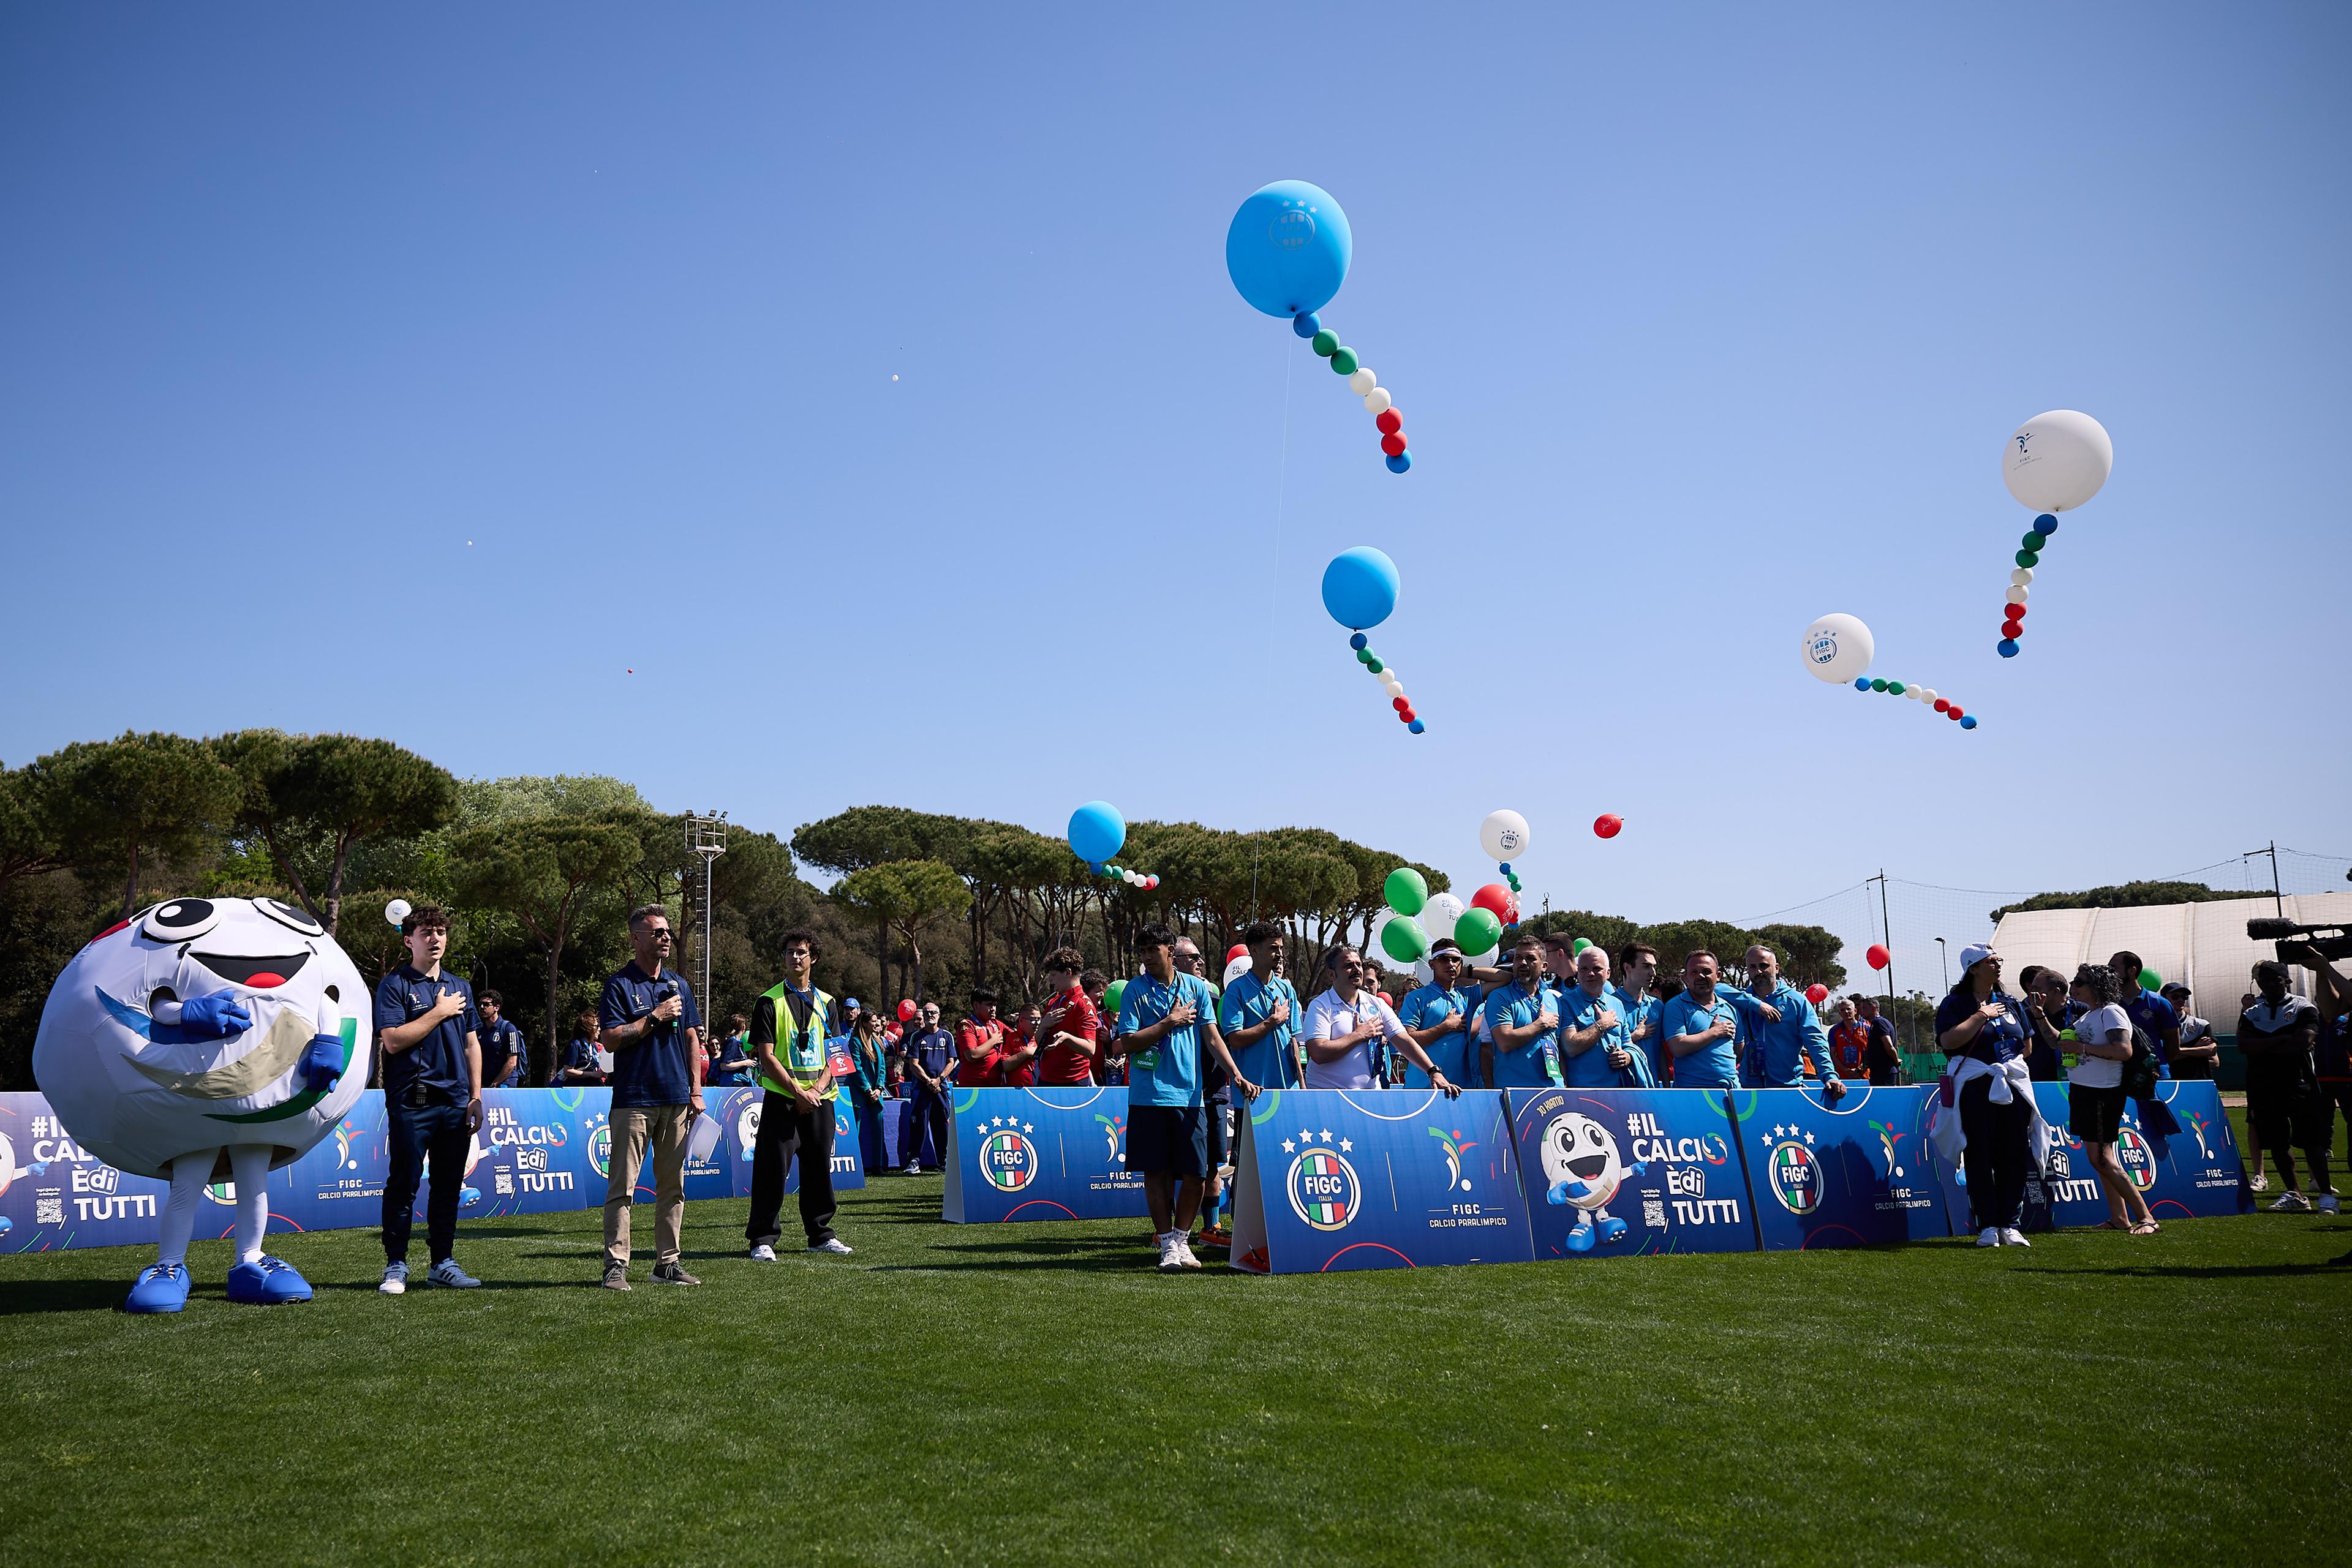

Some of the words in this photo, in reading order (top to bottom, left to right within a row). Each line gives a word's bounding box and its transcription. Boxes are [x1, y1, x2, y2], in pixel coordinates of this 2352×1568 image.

[1815, 646, 1830, 655] FIGC
[488, 1107, 518, 1126] #IL
[1627, 1113, 1665, 1137] #IL
[516, 1147, 531, 1170] È
[527, 1150, 547, 1170] di
[993, 1151, 1023, 1165] FIGC
[2051, 1152, 2069, 1177] di
[2121, 1148, 2144, 1164] FIGC
[71, 1164, 89, 1193] È
[89, 1167, 118, 1193] di
[519, 1172, 574, 1192] TUTTI
[1109, 1172, 1132, 1180] FIGC
[1665, 1164, 1683, 1195] È
[1680, 1167, 1704, 1197] di
[1781, 1166, 1810, 1183] FIGC
[2206, 1169, 2223, 1178] FIGC
[339, 1179, 363, 1189] FIGC
[1304, 1176, 1342, 1195] FIGC
[2047, 1179, 2099, 1202] TUTTI
[318, 1191, 341, 1200] CALCIO
[342, 1189, 383, 1198] PARALIMPICO
[1891, 1188, 1911, 1199] FIGC
[73, 1194, 156, 1221] TUTTI
[1452, 1204, 1480, 1215] FIGC
[1671, 1199, 1741, 1226] TUTTI
[1896, 1200, 1931, 1208] PARALIMPICO
[1429, 1219, 1456, 1227] CALCIO
[1458, 1217, 1507, 1227] PARALIMPICO
